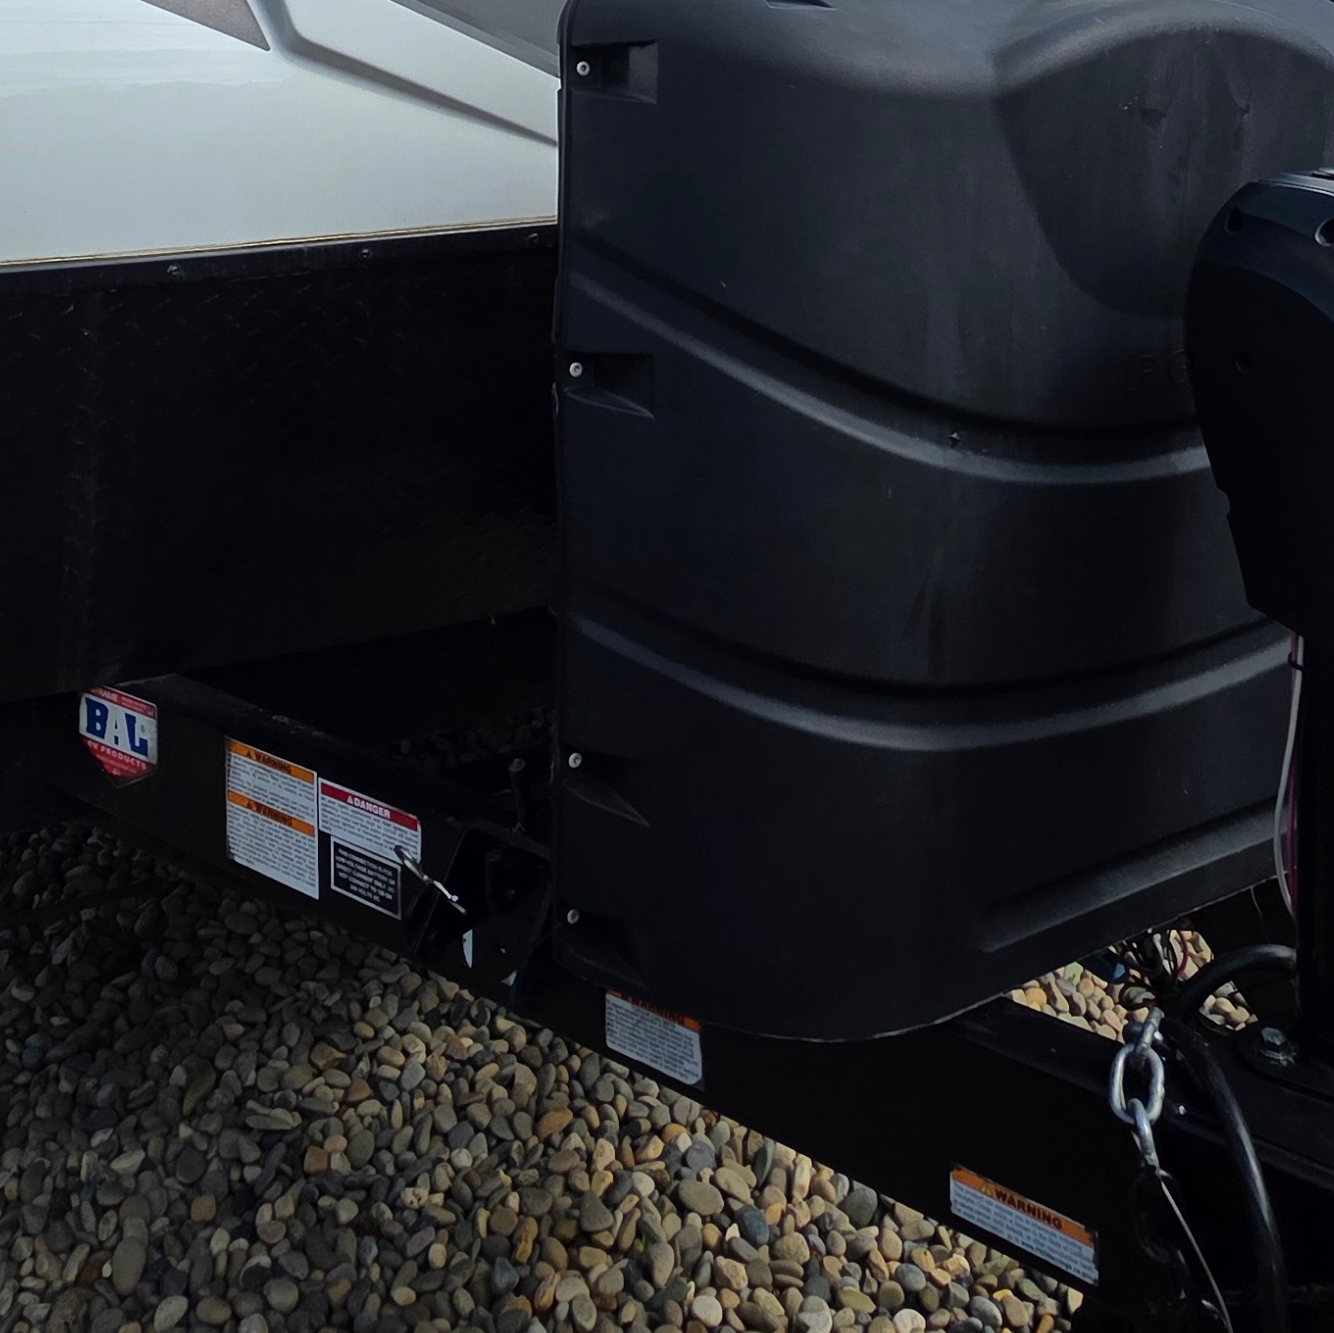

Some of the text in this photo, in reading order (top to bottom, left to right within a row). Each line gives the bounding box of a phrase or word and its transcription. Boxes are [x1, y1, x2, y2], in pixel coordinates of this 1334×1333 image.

[85, 697, 148, 757] BAL
[100, 745, 147, 770] PRODUCTS
[354, 797, 391, 819] DANGER
[995, 1188, 1062, 1229] WARNING
